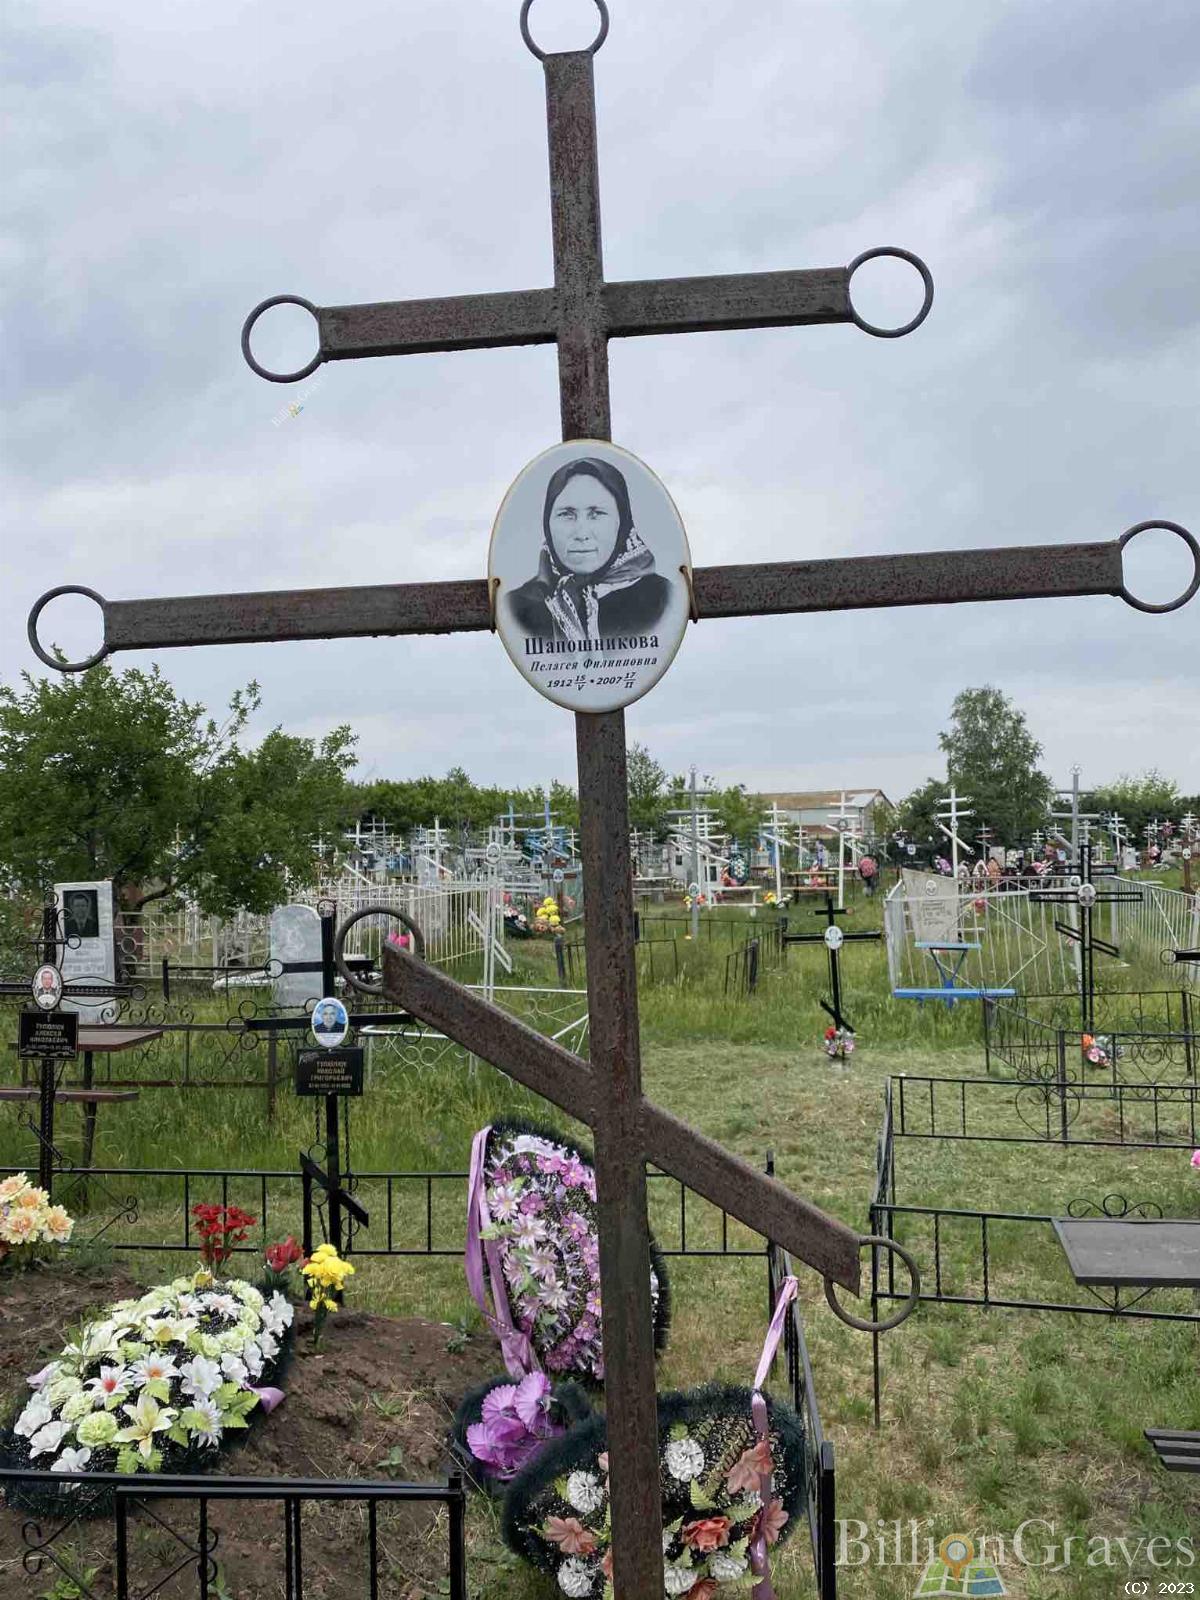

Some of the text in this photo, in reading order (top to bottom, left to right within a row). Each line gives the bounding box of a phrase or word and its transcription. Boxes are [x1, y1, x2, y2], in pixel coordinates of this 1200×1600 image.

[525, 635, 659, 655] Шапошникова
[530, 657, 658, 672] Пелагея Филипповна
[547, 679, 573, 688] 1912
[596, 676, 623, 685] 2007
